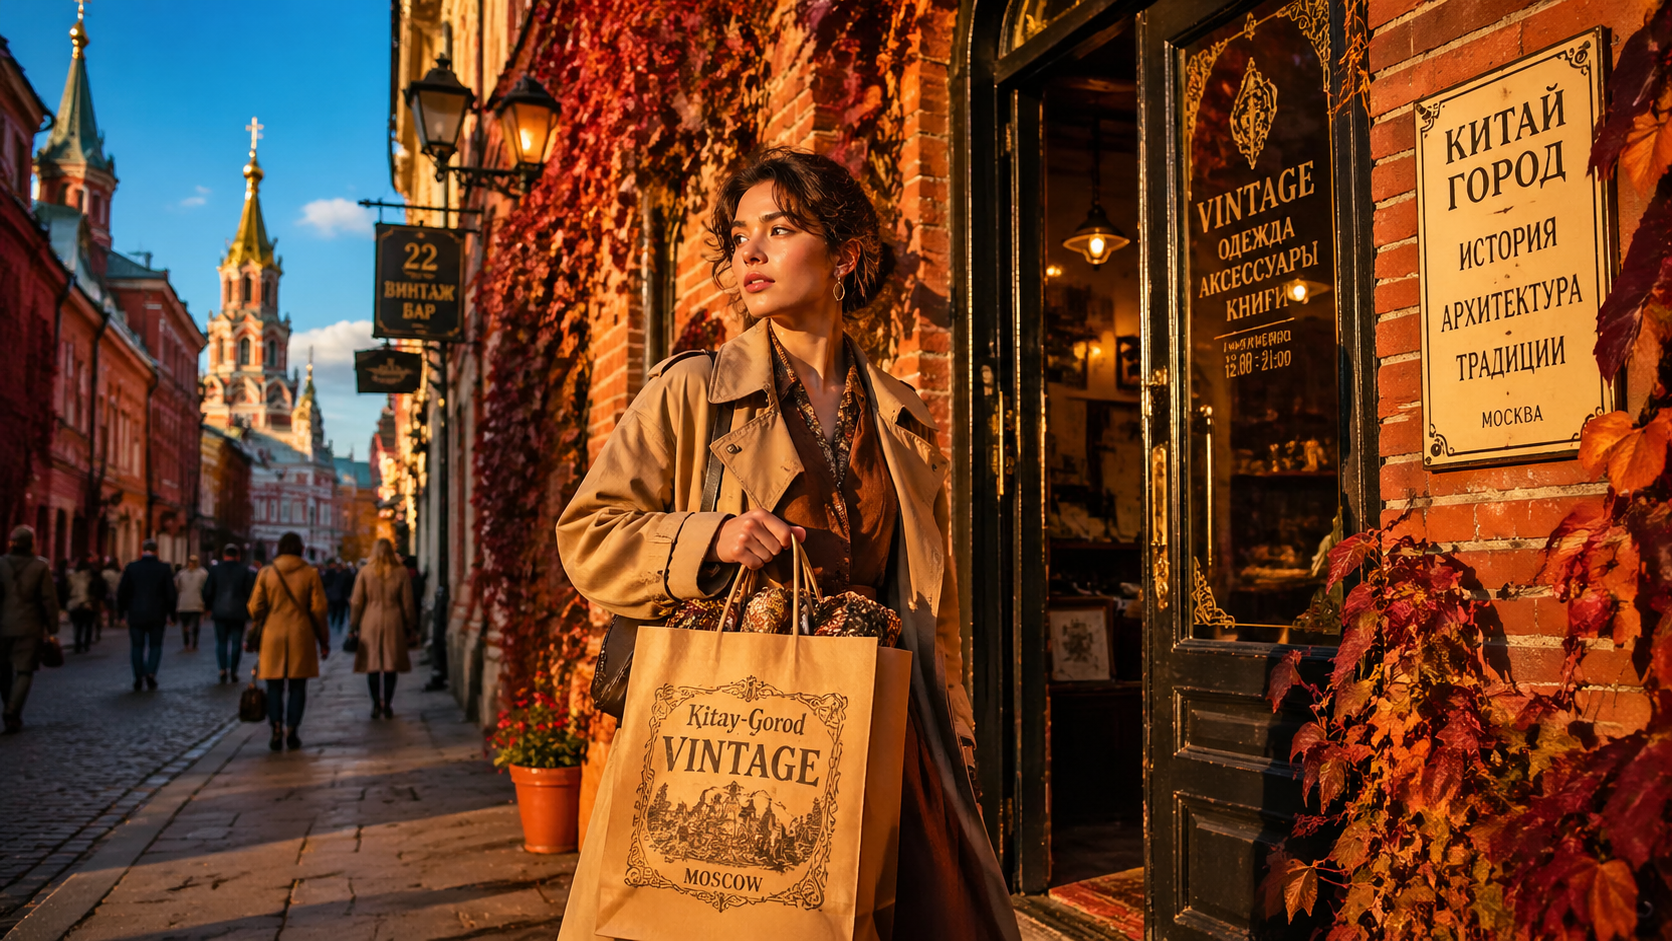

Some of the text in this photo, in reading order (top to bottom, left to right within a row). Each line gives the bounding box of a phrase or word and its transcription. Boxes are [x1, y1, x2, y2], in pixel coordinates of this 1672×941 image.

[1445, 83, 1566, 165] КИТАЙ
[1197, 160, 1315, 233] VINTAGE
[1448, 140, 1566, 211] ГОРОД
[403, 242, 438, 271] 22
[1218, 217, 1295, 261] ОДЕЖДА
[1459, 216, 1558, 271] ИСТОРИЯ
[384, 280, 455, 301] ВИНТАЖ
[1199, 241, 1319, 298] АКСЕССУАРЫ
[402, 302, 436, 320] БАР
[1441, 273, 1583, 333] АРХИТЕКТУРА
[1456, 335, 1566, 381] ТРАДИЦИИ
[1482, 405, 1543, 428] МОСКВА
[686, 704, 807, 735] Kitay-Gorod
[663, 735, 820, 787] VINTAGE
[684, 868, 763, 892] MOSCOW
